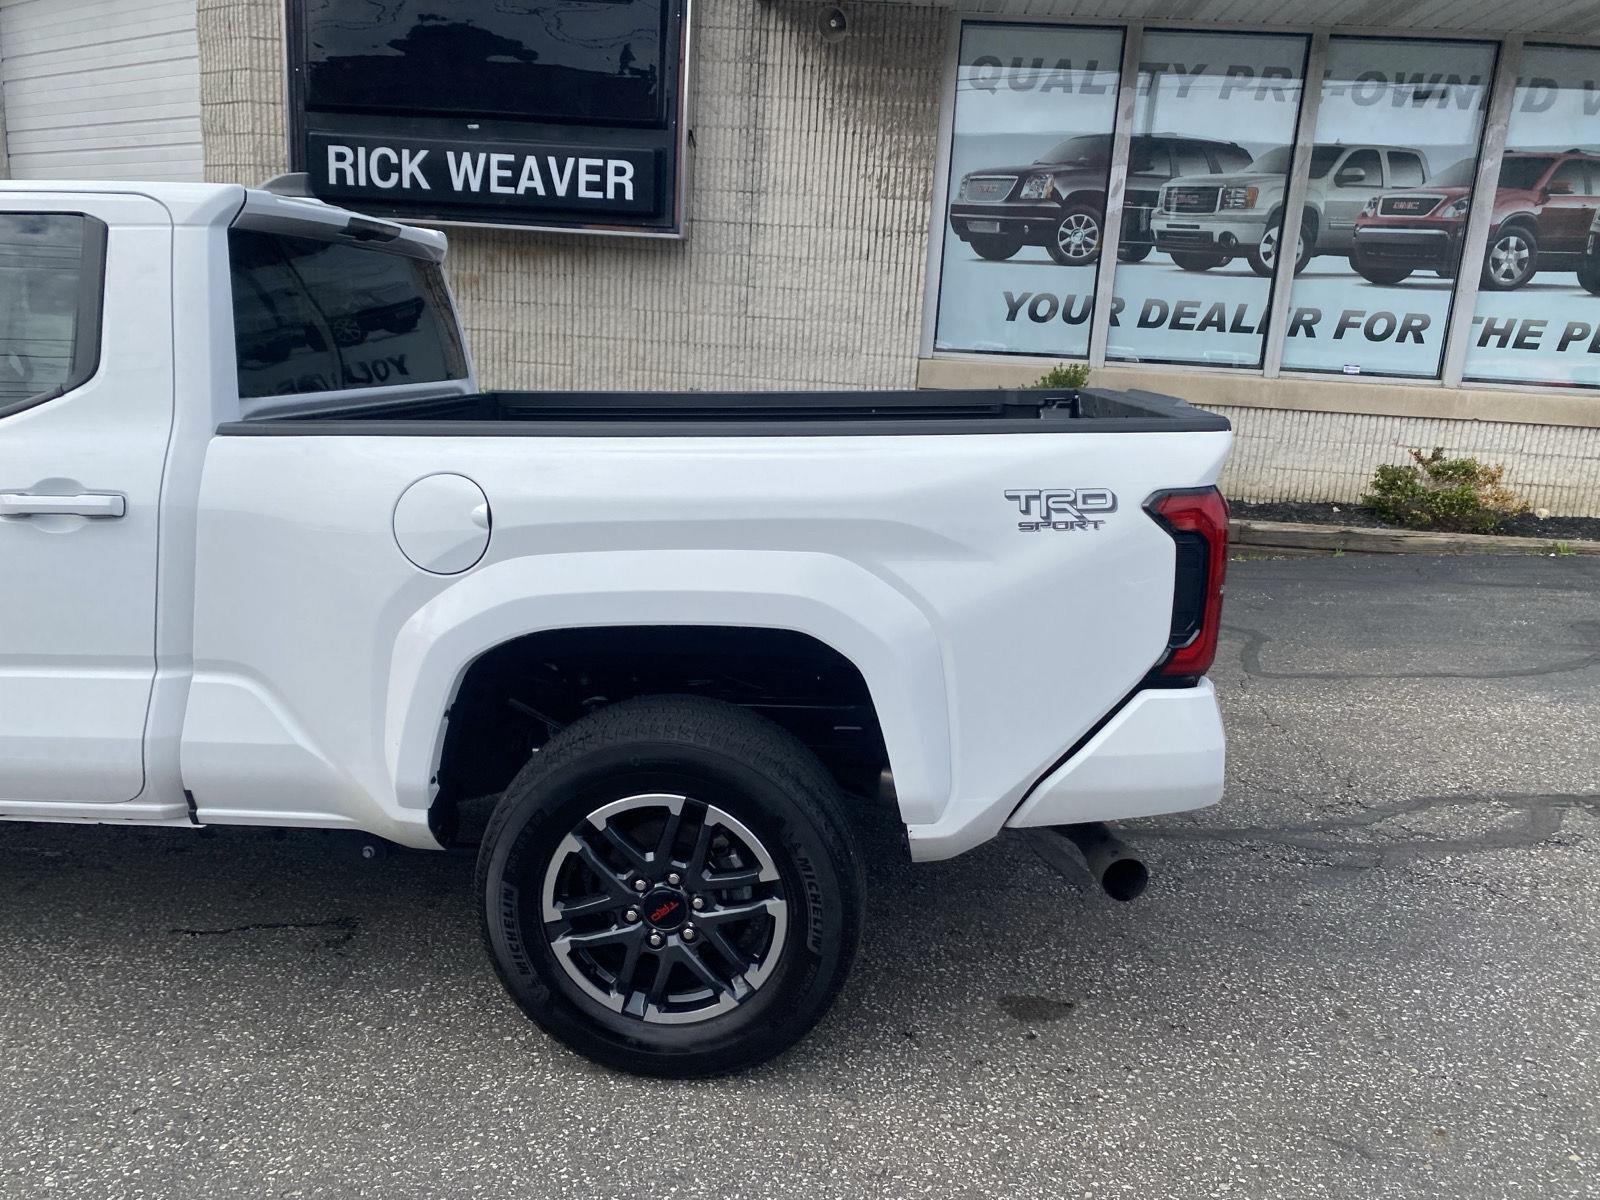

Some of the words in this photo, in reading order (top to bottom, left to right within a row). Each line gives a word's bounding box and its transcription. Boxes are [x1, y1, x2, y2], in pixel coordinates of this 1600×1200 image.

[969, 55, 1207, 98] QUALTY
[1218, 65, 1559, 113] PR-OWND
[327, 145, 431, 190] RICK
[446, 151, 635, 200] WEAVER
[1003, 291, 1125, 327] YOUR
[1333, 309, 1431, 344] FOR
[1004, 488, 1118, 522] TRD
[1018, 520, 1105, 532] SPORT
[651, 901, 679, 921] TRD
[796, 857, 824, 950] MICHELIN
[502, 887, 531, 976] MICHELIN
